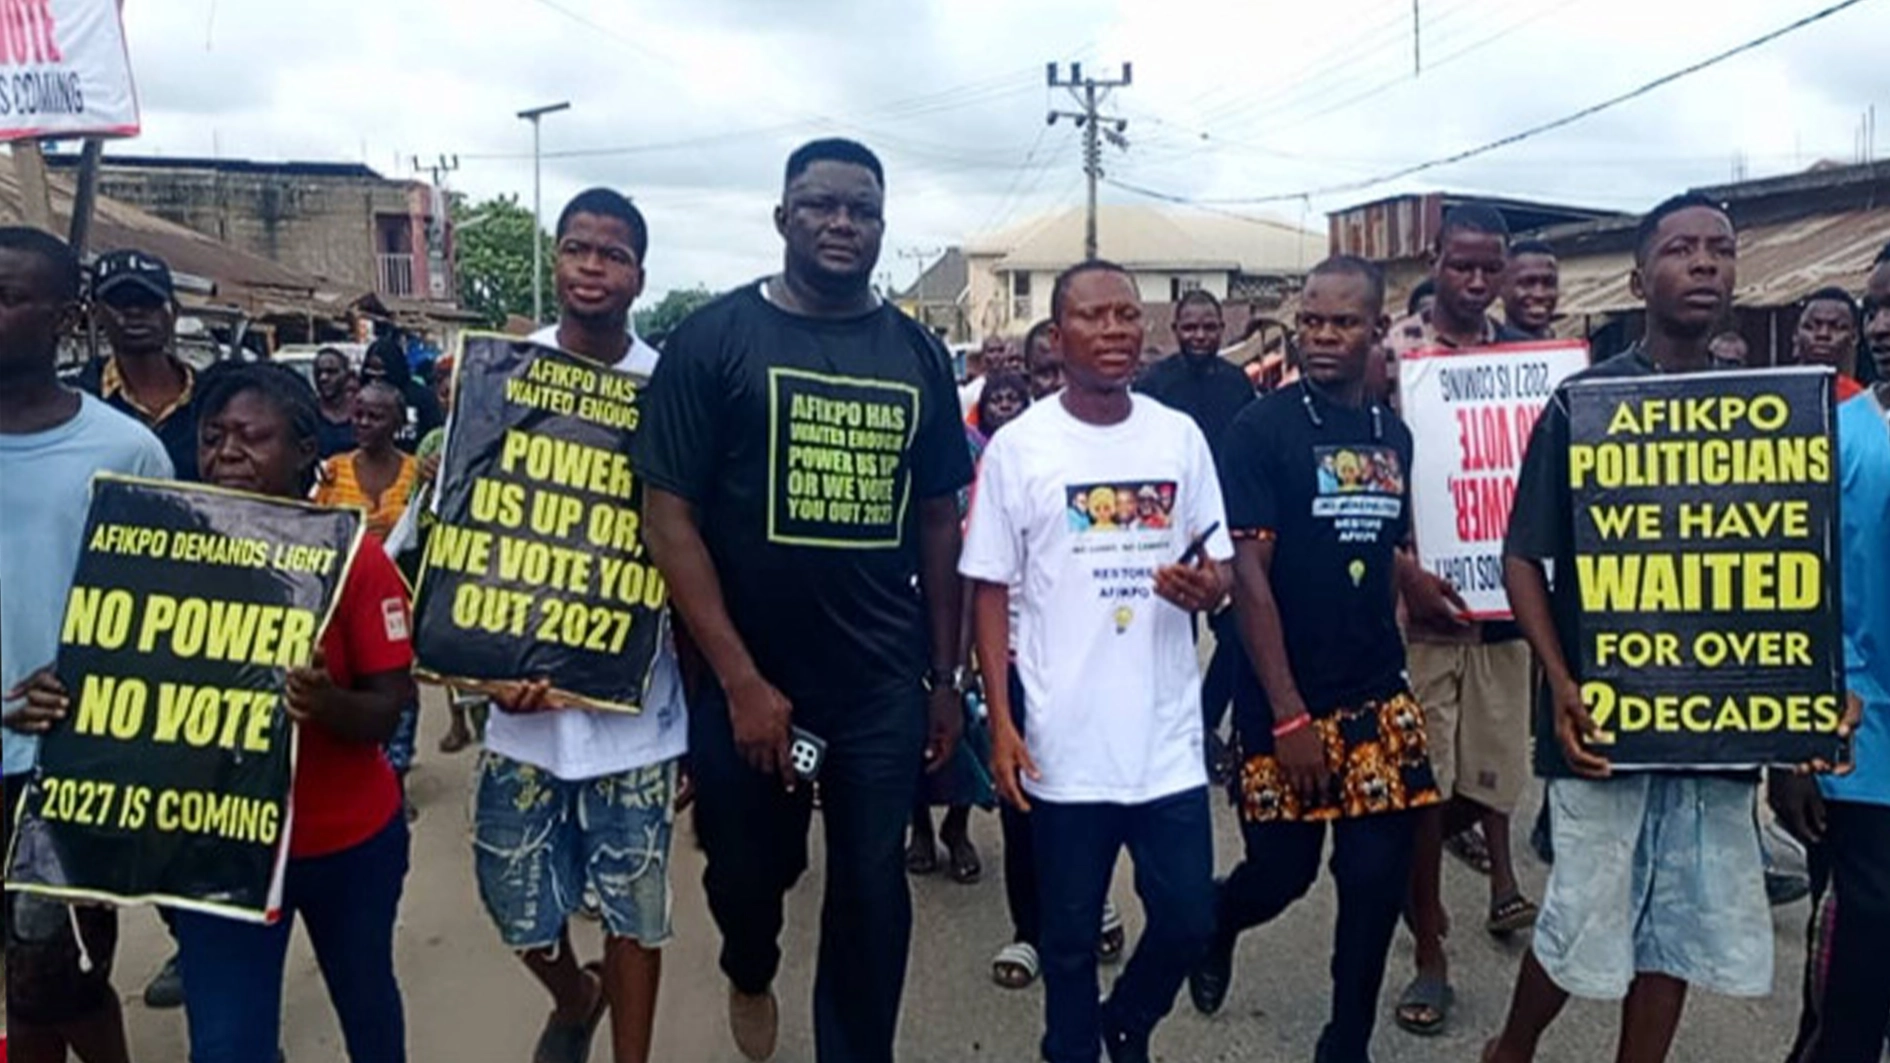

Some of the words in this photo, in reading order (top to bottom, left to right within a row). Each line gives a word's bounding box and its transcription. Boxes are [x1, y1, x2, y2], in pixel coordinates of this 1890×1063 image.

[12, 71, 84, 114] COMING
[506, 378, 575, 416] WAITED
[527, 358, 597, 394] AFIKPO
[600, 373, 637, 404] HAS
[1440, 366, 1495, 401] COMING
[1499, 365, 1512, 399] IS
[1516, 363, 1550, 398] 2027
[790, 393, 861, 426] AFIKPO
[866, 403, 905, 431] HAS
[1606, 394, 1789, 436] AFIKPO
[1457, 407, 1514, 471] VOTE
[501, 428, 635, 499] POWER
[788, 446, 854, 474] POWER
[856, 453, 877, 477] US
[1569, 436, 1830, 489] POLITICIANS
[788, 470, 818, 498] OR
[822, 474, 855, 500] WE
[470, 477, 524, 528] US
[531, 489, 583, 538] UP
[588, 504, 644, 556] OR,
[787, 497, 825, 519] YOU
[829, 501, 860, 524] OUT
[1590, 504, 1661, 540] WE
[1679, 501, 1809, 539] HAVE
[89, 523, 167, 558] AFIKPO
[170, 532, 268, 568] DEMANDS
[271, 544, 338, 575] LIGHT
[430, 523, 492, 576] WE
[499, 535, 592, 595] VOTE
[600, 556, 667, 609] YOU
[1575, 551, 1821, 613] WAITED
[61, 586, 133, 650] NO
[136, 593, 316, 668] POWER
[452, 583, 533, 636] OUT
[536, 598, 632, 655] 2027
[1596, 633, 1680, 668] FOR
[1694, 631, 1813, 668] OVER
[75, 674, 147, 739] NO
[153, 682, 278, 752] VOTE
[40, 777, 115, 827] 2027
[118, 784, 152, 830] IS
[156, 789, 279, 846] COMING
